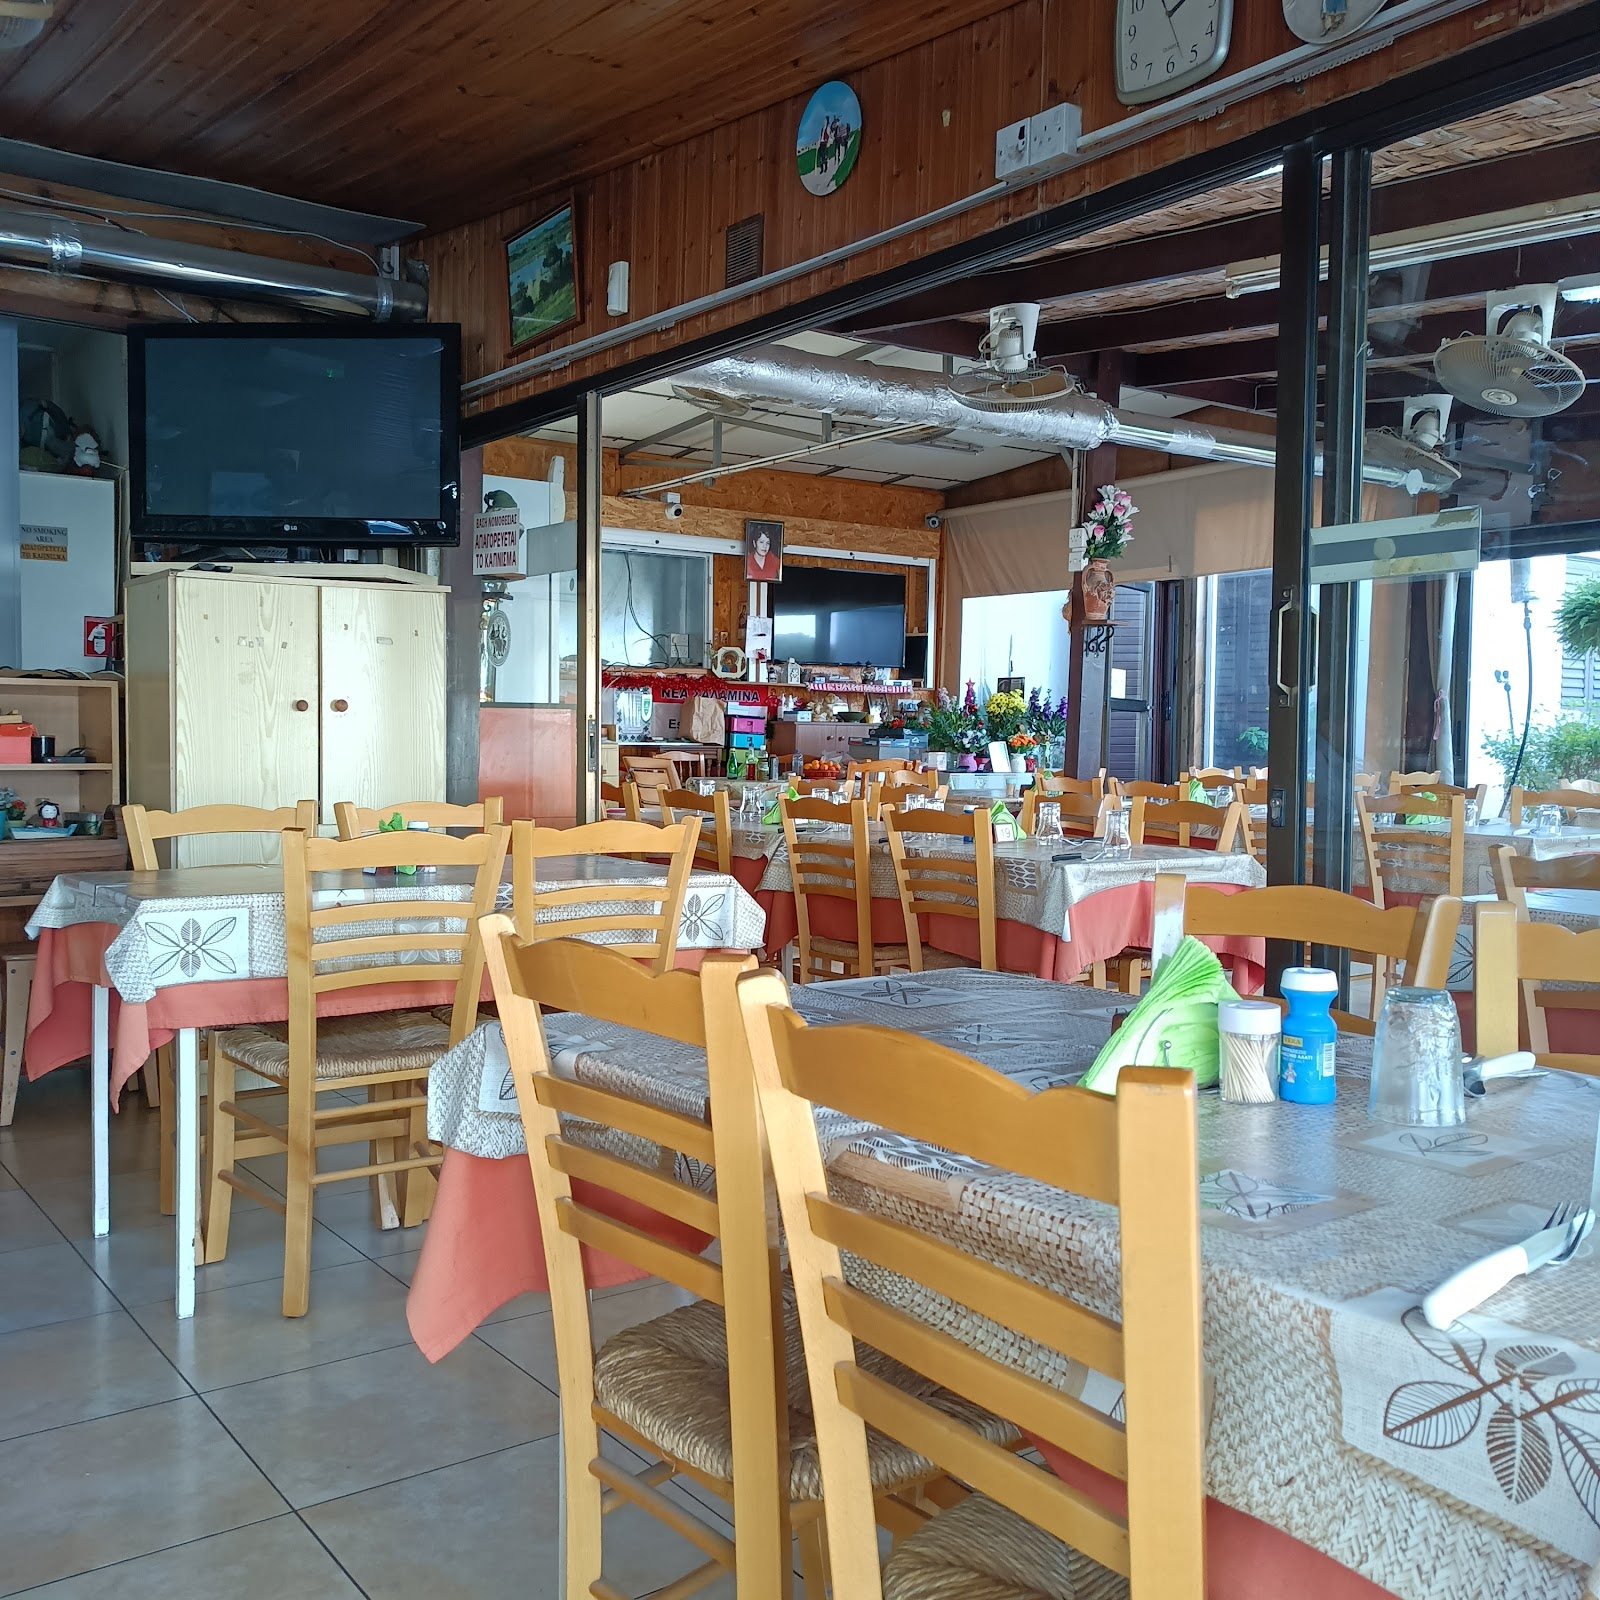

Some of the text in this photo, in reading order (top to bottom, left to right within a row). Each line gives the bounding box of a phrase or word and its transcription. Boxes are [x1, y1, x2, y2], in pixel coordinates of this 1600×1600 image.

[1128, 24, 1137, 44] 9
[1205, 20, 1214, 37] 4
[1130, 53, 1138, 71] 8
[1189, 43, 1199, 64] 5
[1145, 62, 1153, 80] 7
[1166, 55, 1175, 74] 6
[21, 526, 68, 537] NO SMOKING
[35, 535, 54, 543] AREA
[474, 531, 518, 549] ΑΠΑΓΟΡΕΥΕΤΑΙ
[476, 551, 517, 569] ΤΟ ΚΑΠΝΙΣΜΑ
[661, 688, 688, 699] ΝΕΑ
